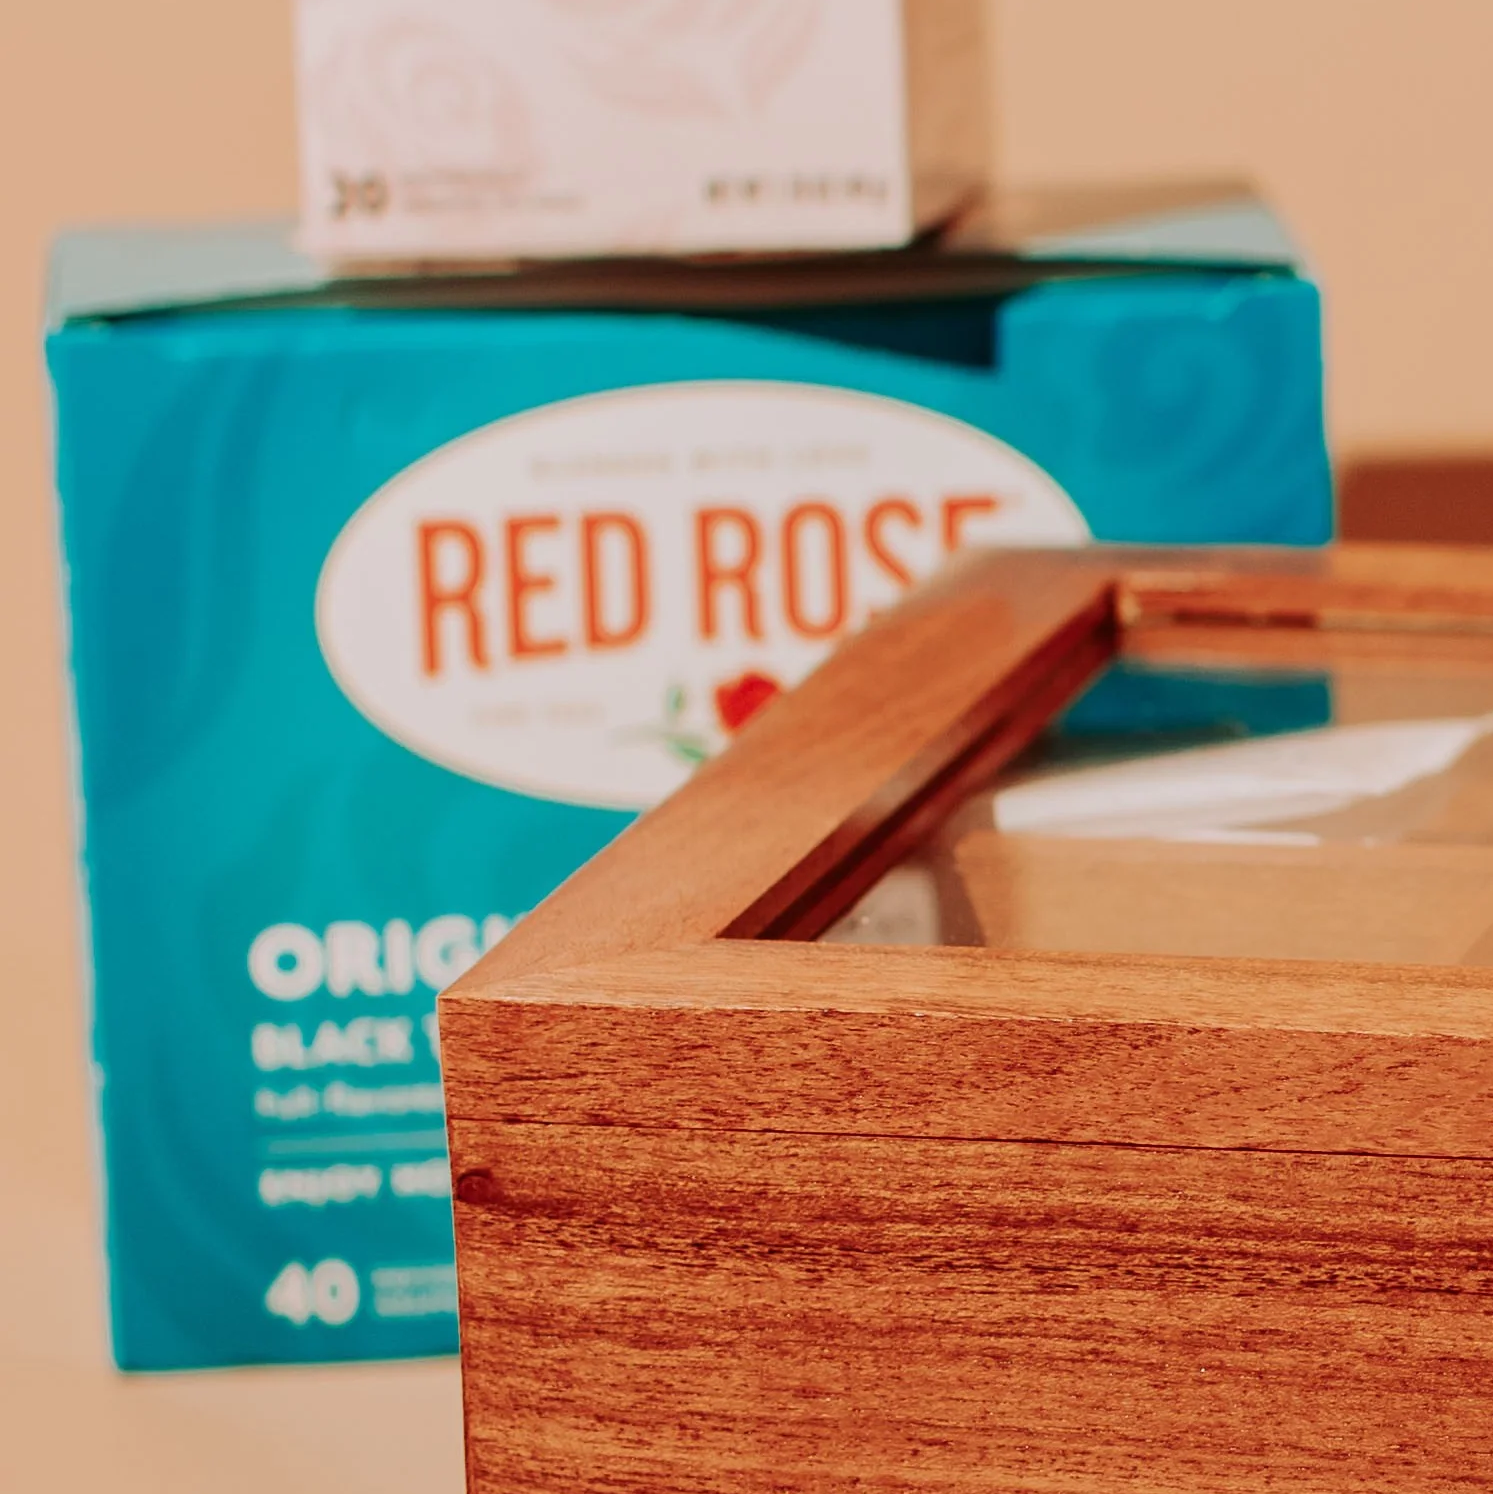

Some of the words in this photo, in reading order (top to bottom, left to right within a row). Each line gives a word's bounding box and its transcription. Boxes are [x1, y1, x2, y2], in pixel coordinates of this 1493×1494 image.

[416, 510, 650, 680] RED
[248, 913, 528, 1001] ORIG
[251, 1015, 414, 1071] BLACK
[266, 1258, 360, 1326] 40
